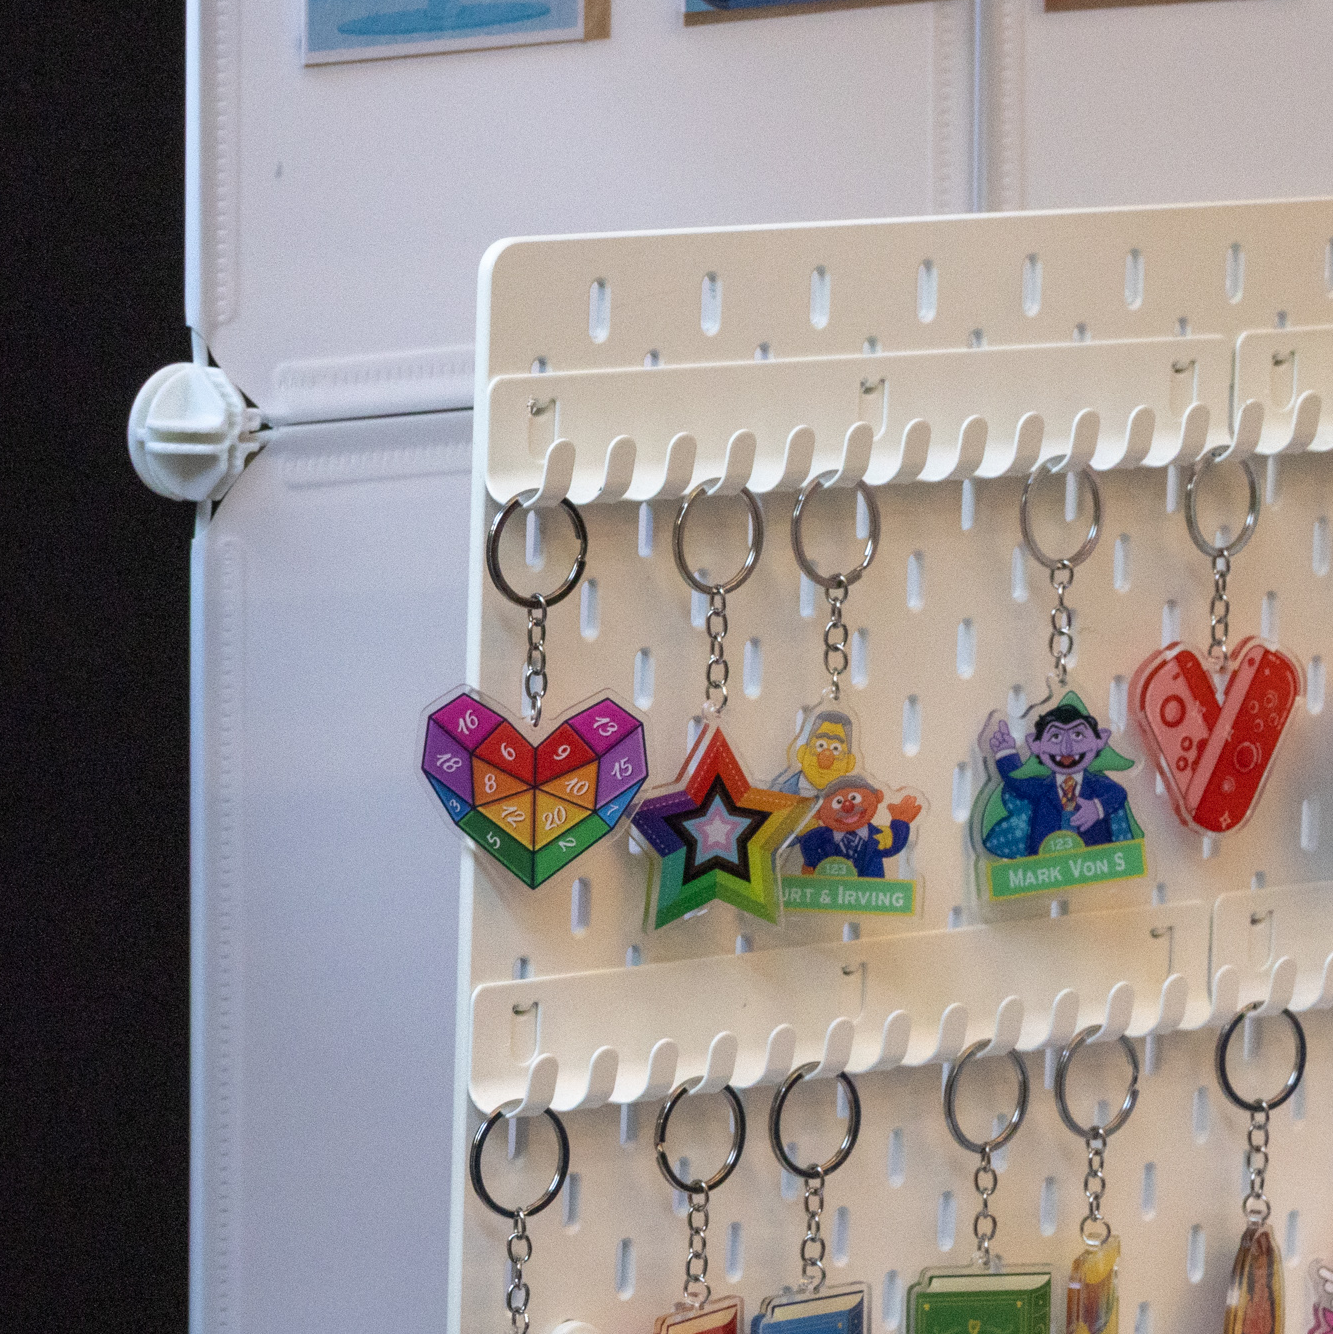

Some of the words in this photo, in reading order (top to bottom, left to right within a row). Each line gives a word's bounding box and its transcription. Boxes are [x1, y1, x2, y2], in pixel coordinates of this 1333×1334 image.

[457, 710, 479, 735] 16
[592, 716, 618, 737] 13
[500, 742, 516, 761] 6
[553, 744, 571, 761] 9
[436, 753, 462, 773] 18
[610, 757, 634, 780] 15
[484, 773, 497, 793] 8
[564, 777, 589, 796] 10
[501, 805, 526, 828] 12
[542, 805, 567, 831] 20
[1050, 838, 1073, 851] 123
[1008, 866, 1062, 888] MARK
[1069, 859, 1108, 878] VON
[1114, 852, 1125, 871] S
[838, 885, 905, 907] IRVING
